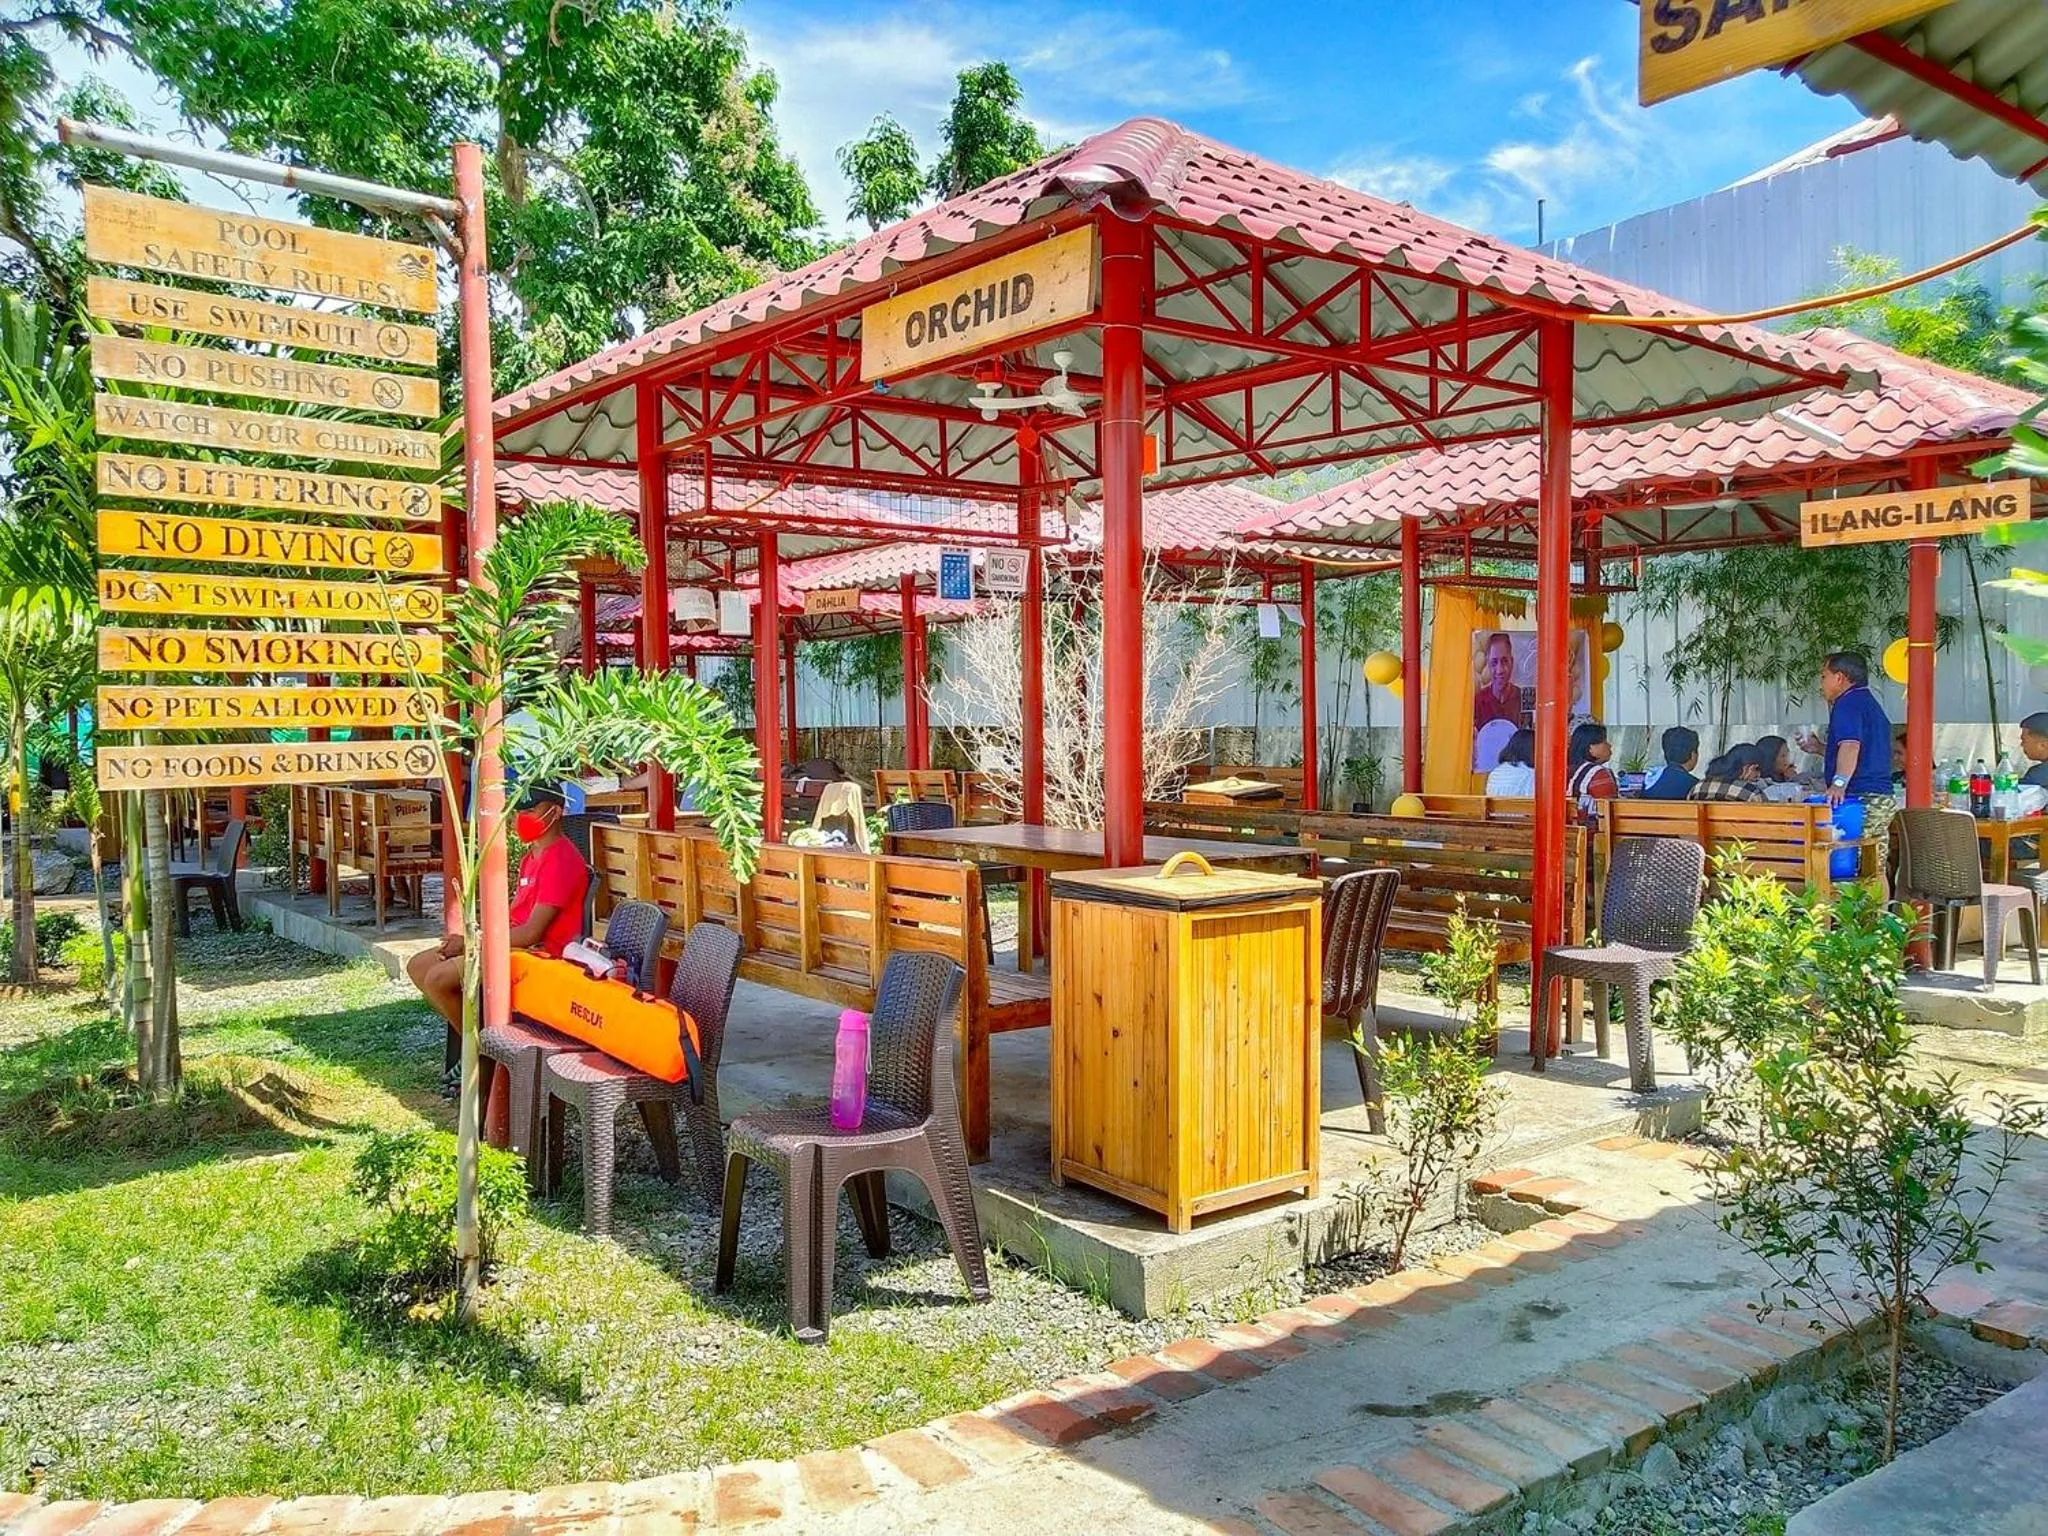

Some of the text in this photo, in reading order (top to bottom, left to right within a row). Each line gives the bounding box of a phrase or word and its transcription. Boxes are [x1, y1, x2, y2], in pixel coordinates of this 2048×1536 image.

[218, 219, 308, 256] POOL
[143, 244, 392, 305] SAFETY RULES
[130, 293, 361, 347] USE SWIMSUIT
[905, 272, 1035, 349] ORCHID
[135, 351, 351, 399] NO PUSHING
[103, 405, 438, 460] WATCH YOUR CHILDREN
[106, 460, 390, 512] NO LITTERING
[1811, 494, 2017, 535] ILANG-ILANG
[135, 519, 377, 567] NO DIVING
[992, 558, 1005, 570] NO
[212, 586, 295, 609] SWIM
[306, 589, 402, 612] ALONE
[816, 596, 846, 610] DAHLIA
[125, 635, 391, 668] NO SMOKING
[106, 696, 397, 719] NO PETS ALLOWED
[107, 757, 153, 780] NO
[164, 754, 262, 779] FOODS
